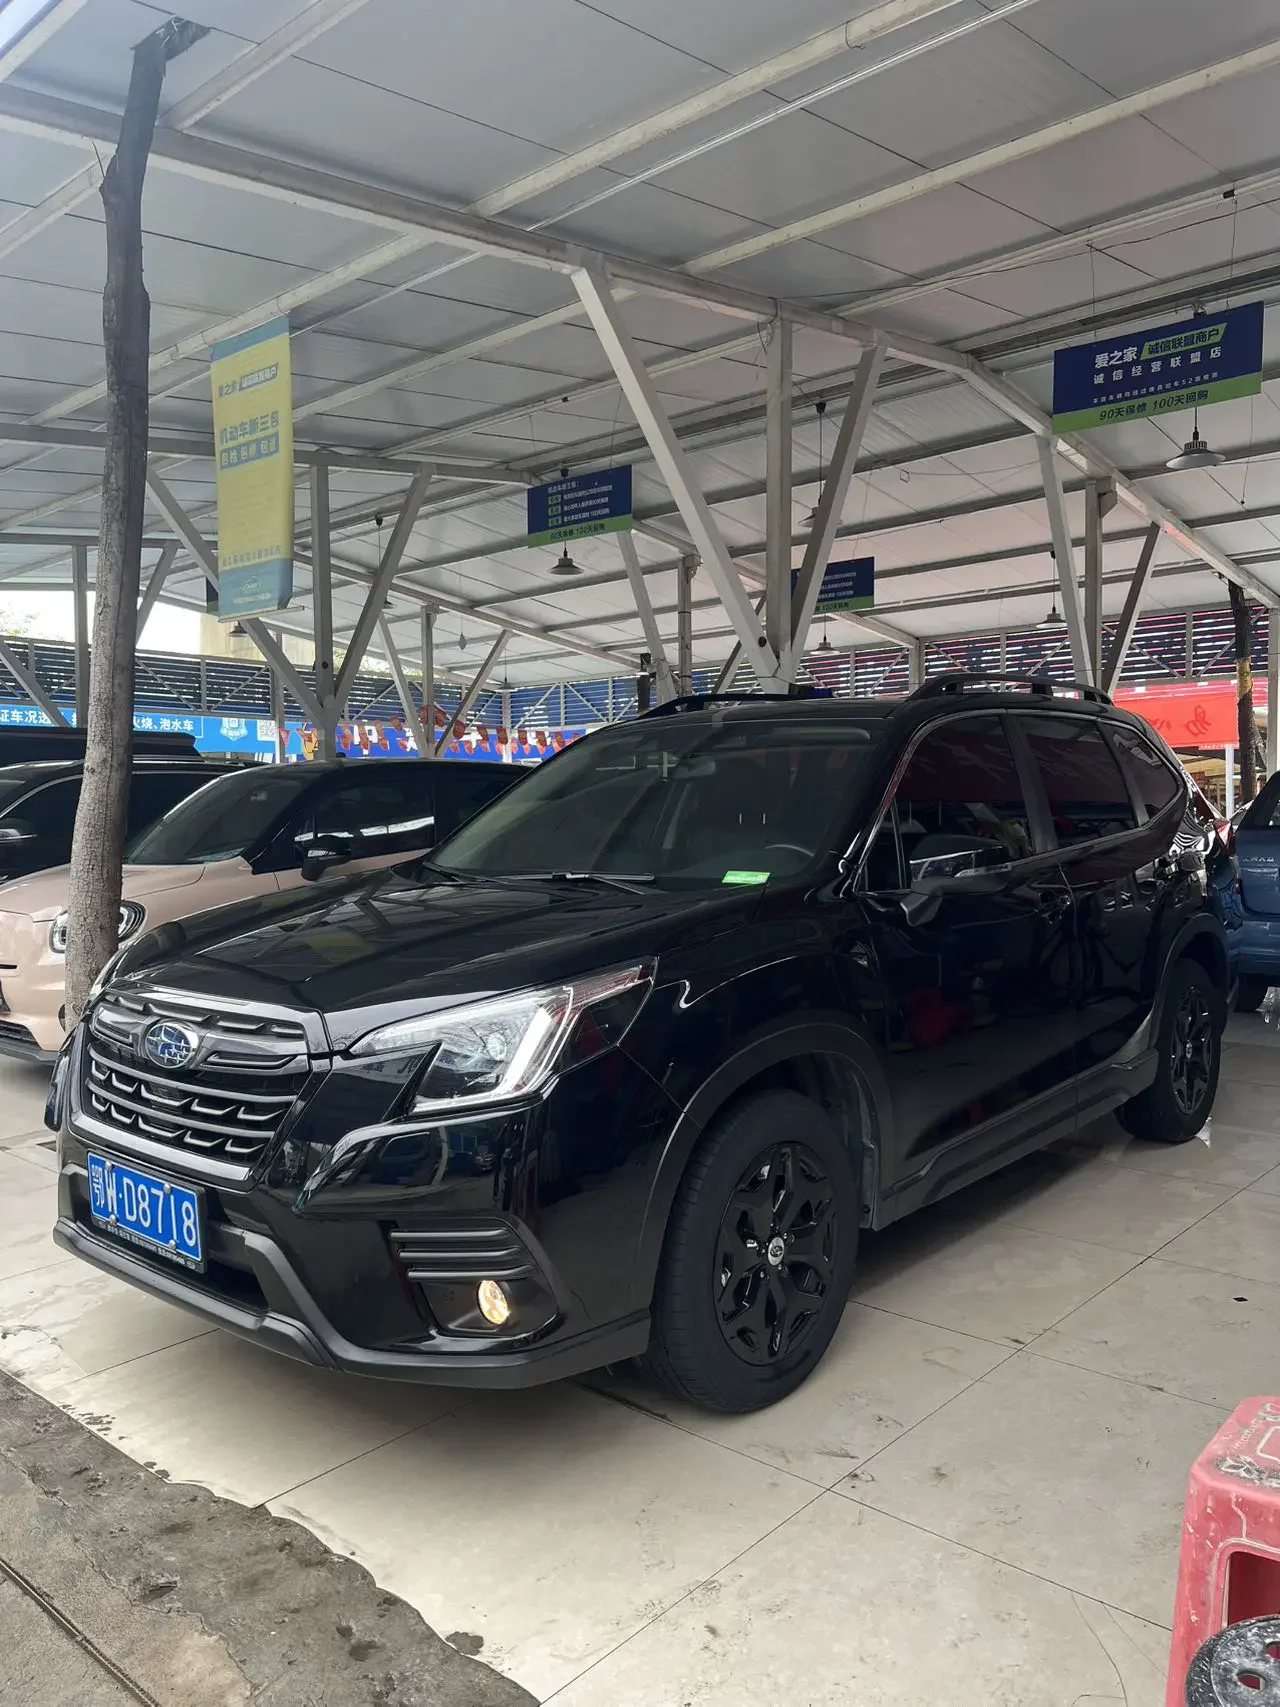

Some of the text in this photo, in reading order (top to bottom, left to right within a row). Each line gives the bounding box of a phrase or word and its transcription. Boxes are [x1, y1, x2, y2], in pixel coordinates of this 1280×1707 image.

[1093, 346, 1222, 385] 诚信经营联盟店
[1094, 327, 1220, 369] 爱之家 诚信联盟商户
[1152, 389, 1209, 411] 100天回购
